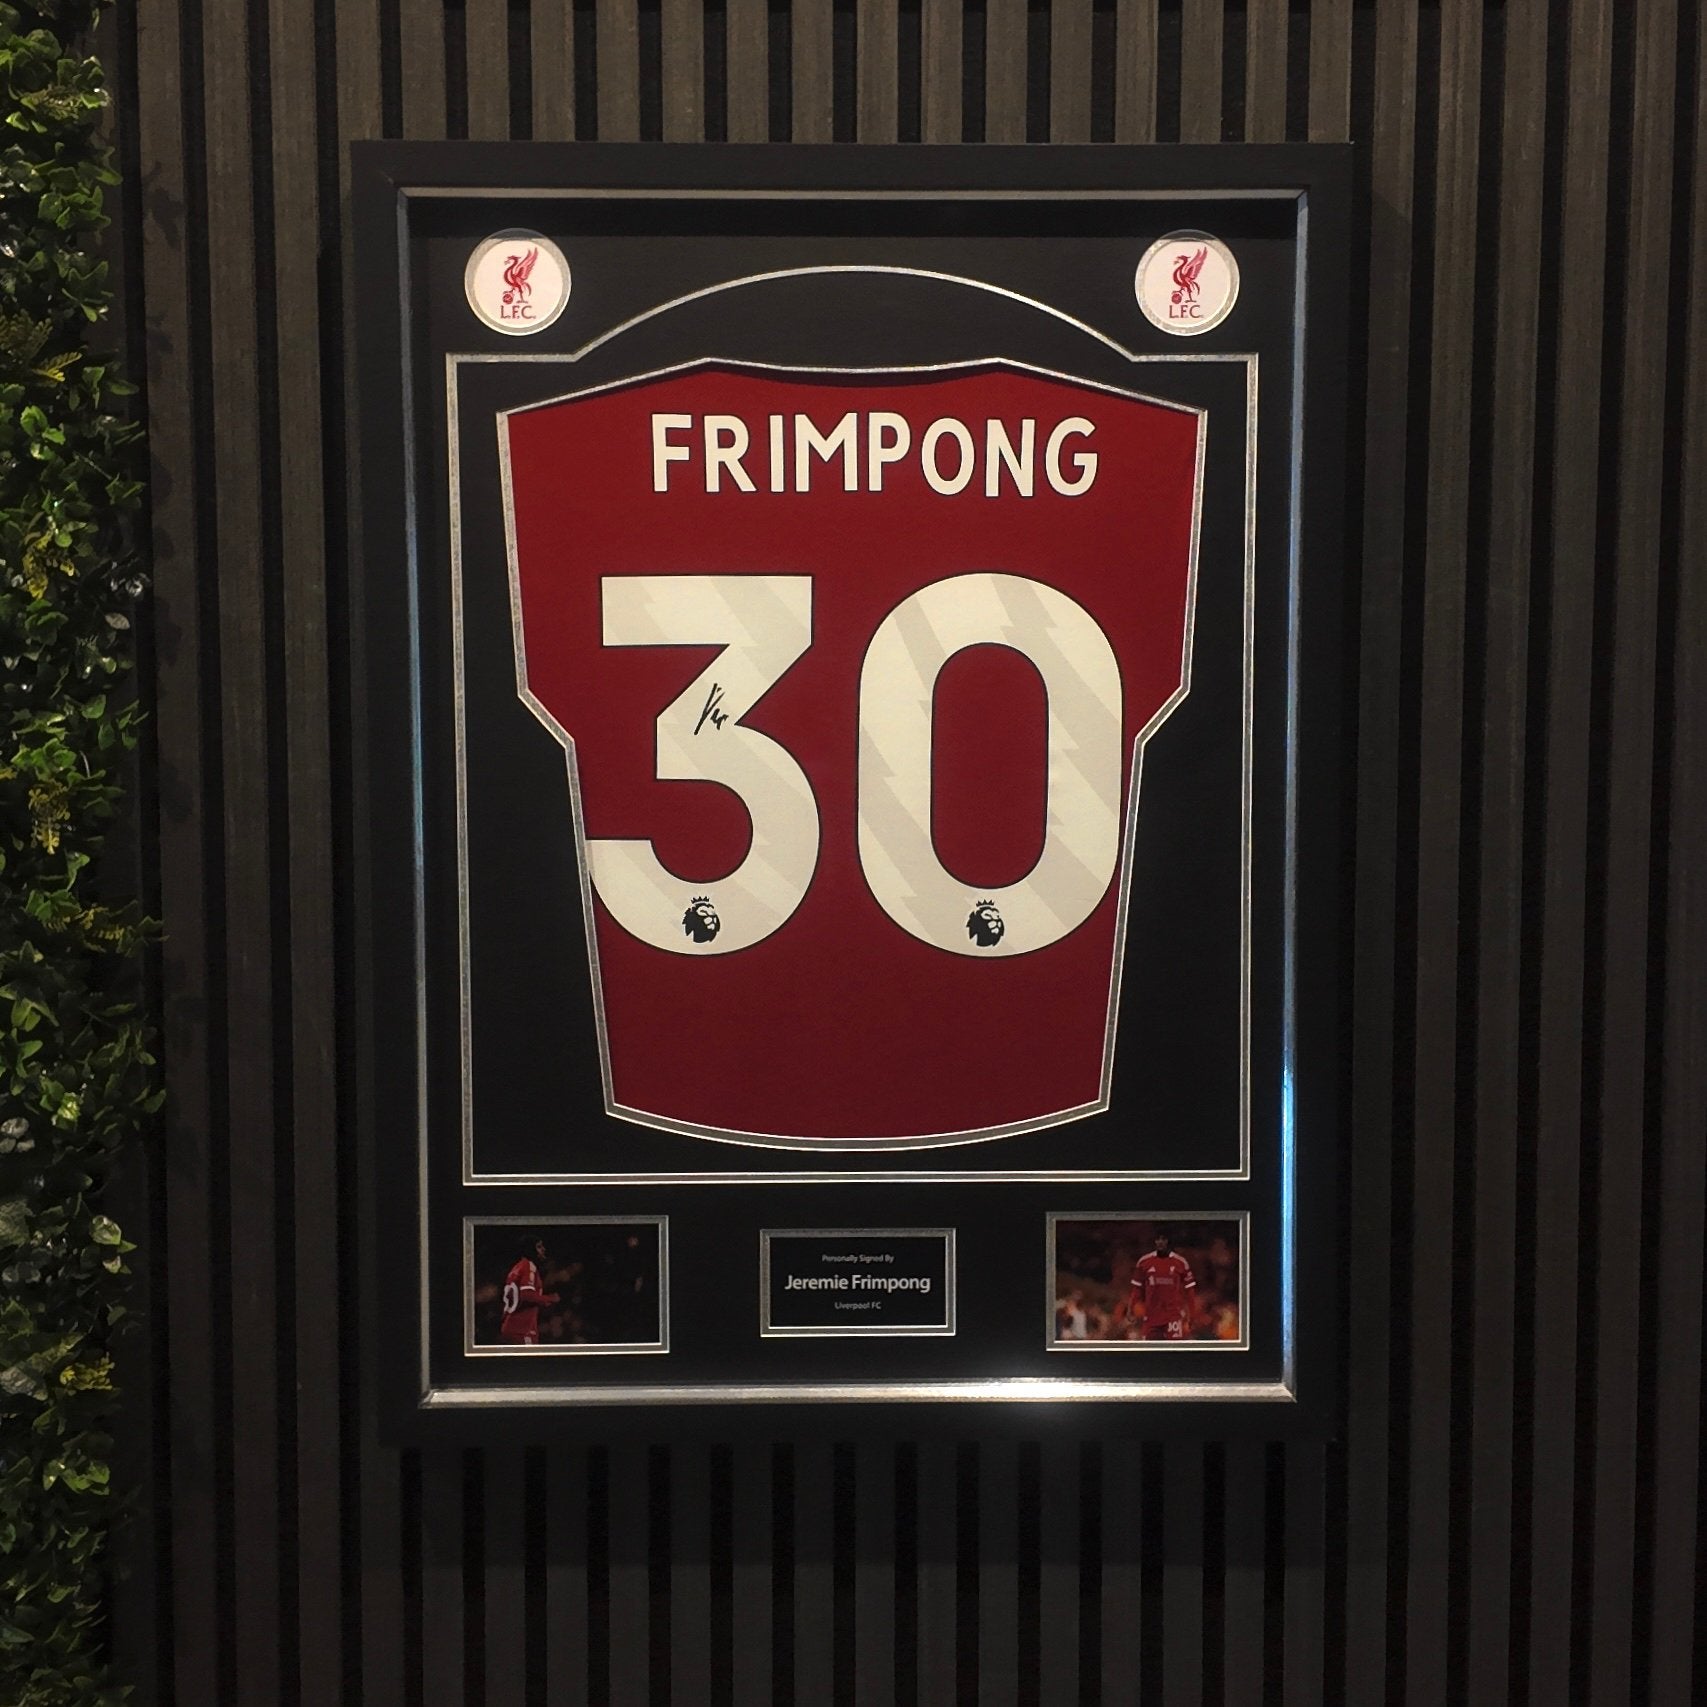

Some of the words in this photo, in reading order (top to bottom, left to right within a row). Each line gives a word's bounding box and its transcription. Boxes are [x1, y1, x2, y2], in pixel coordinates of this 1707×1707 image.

[651, 411, 1099, 498] FRIMPONG
[585, 572, 1123, 957] 30
[821, 1254, 858, 1264] Personally
[859, 1254, 884, 1264] Signed
[885, 1254, 894, 1264] By
[784, 1274, 849, 1290] Jeremie
[851, 1274, 931, 1294] Frimpong
[834, 1301, 870, 1311] Liverpool
[871, 1301, 882, 1310] FC
